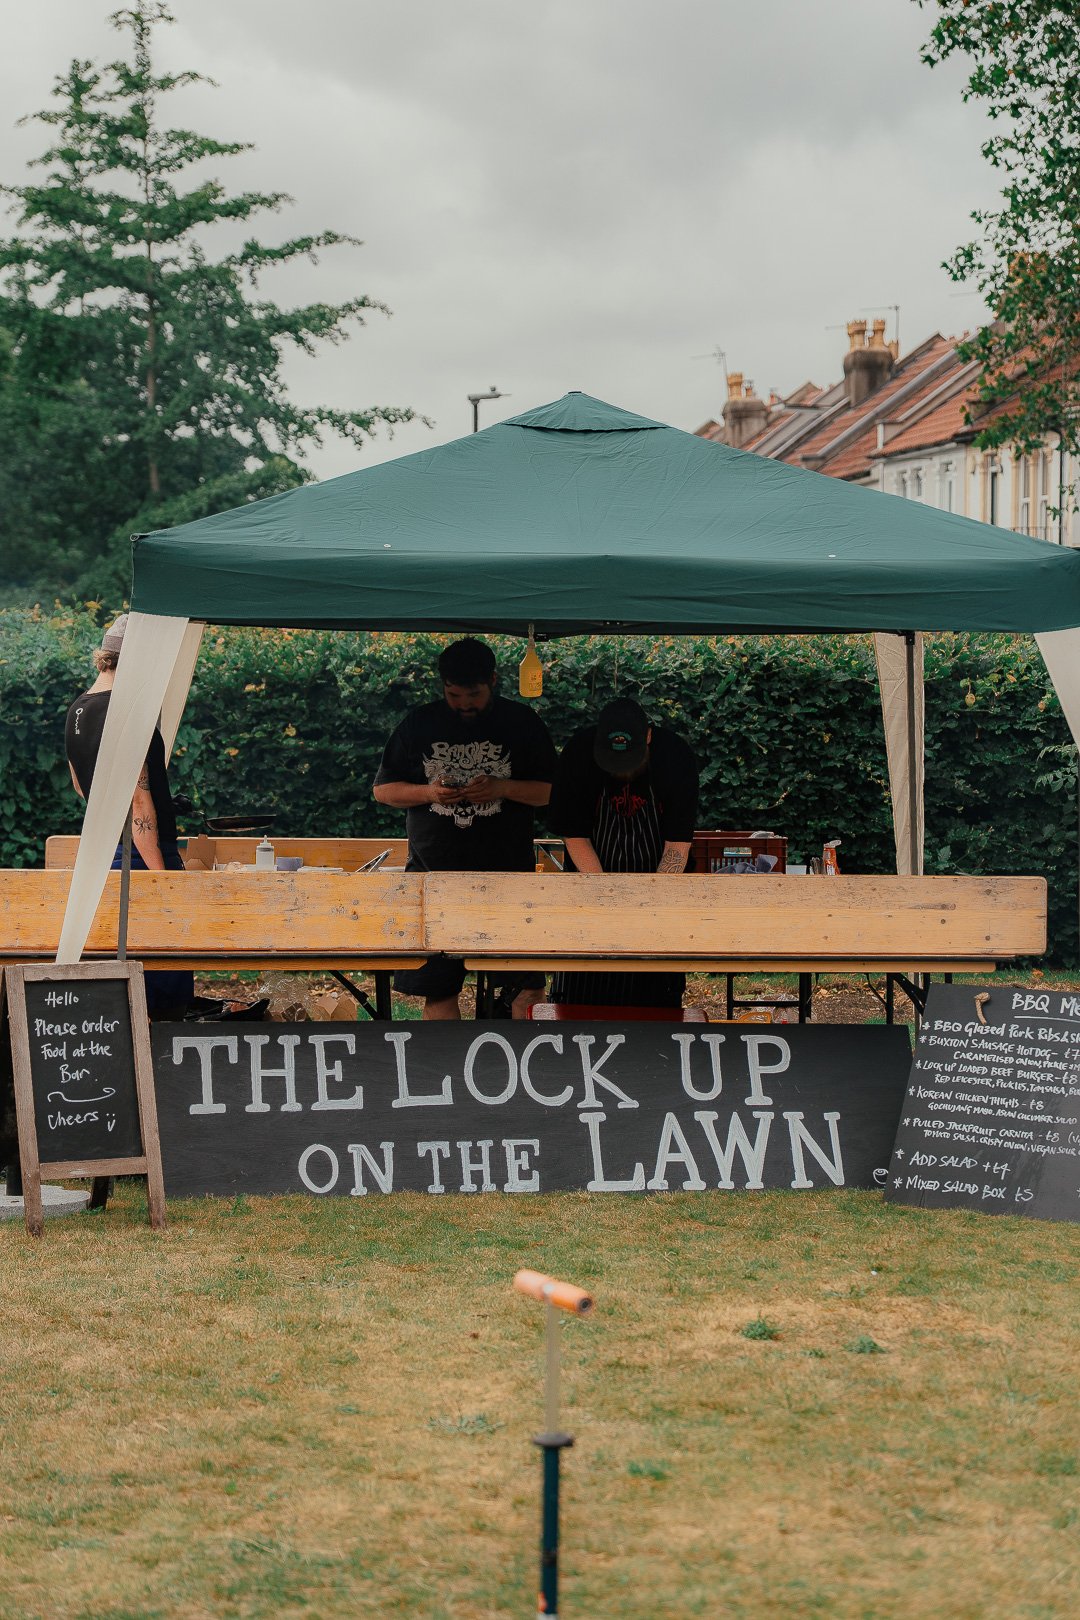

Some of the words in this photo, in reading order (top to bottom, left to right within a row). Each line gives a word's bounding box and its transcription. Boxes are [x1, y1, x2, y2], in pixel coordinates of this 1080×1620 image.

[45, 992, 79, 1007] Hello
[1012, 993, 1050, 1013] BBQ
[34, 1018, 77, 1037] Please
[934, 1020, 962, 1032] BBQ
[1008, 1024, 1034, 1040] Pork
[1038, 1028, 1060, 1042] Ribs
[41, 1042, 67, 1059] Food
[72, 1043, 88, 1058] at
[88, 1041, 112, 1056] the
[928, 1035, 969, 1048] BUXTON
[971, 1039, 1015, 1054] SAUSAGE
[173, 1034, 363, 1114] THE
[384, 1032, 639, 1109] LOCK
[671, 1033, 791, 1107] UP
[923, 1060, 943, 1072] LOCK
[944, 1063, 957, 1072] UP
[958, 1064, 988, 1075] LOADED
[990, 1067, 1014, 1077] BEEF
[1017, 1070, 1054, 1083] BURGER
[935, 1073, 950, 1084] RED
[916, 1085, 953, 1100] KOREAN
[955, 1092, 989, 1104] CHICKEN
[989, 1096, 1019, 1108] THIGHS
[48, 1111, 100, 1130] Cheers
[928, 1102, 972, 1114] GOCHUJANG
[995, 1109, 1017, 1118] ASIAN
[1053, 1116, 1077, 1125] SALAD
[912, 1117, 945, 1129] PULLED
[945, 1121, 996, 1136] JACKFRUIT
[299, 1141, 394, 1196] ON
[418, 1138, 540, 1194] THE
[579, 1110, 845, 1192] LAWN
[923, 1129, 950, 1139] TOMATO
[1030, 1144, 1057, 1157] VEGAN
[1056, 1146, 1077, 1156] SOUR
[909, 1151, 937, 1167] ADD
[938, 1155, 978, 1169] SALAD
[905, 1174, 940, 1191] MIXED
[942, 1180, 979, 1195] SALAD
[982, 1184, 1007, 1200] BOX
